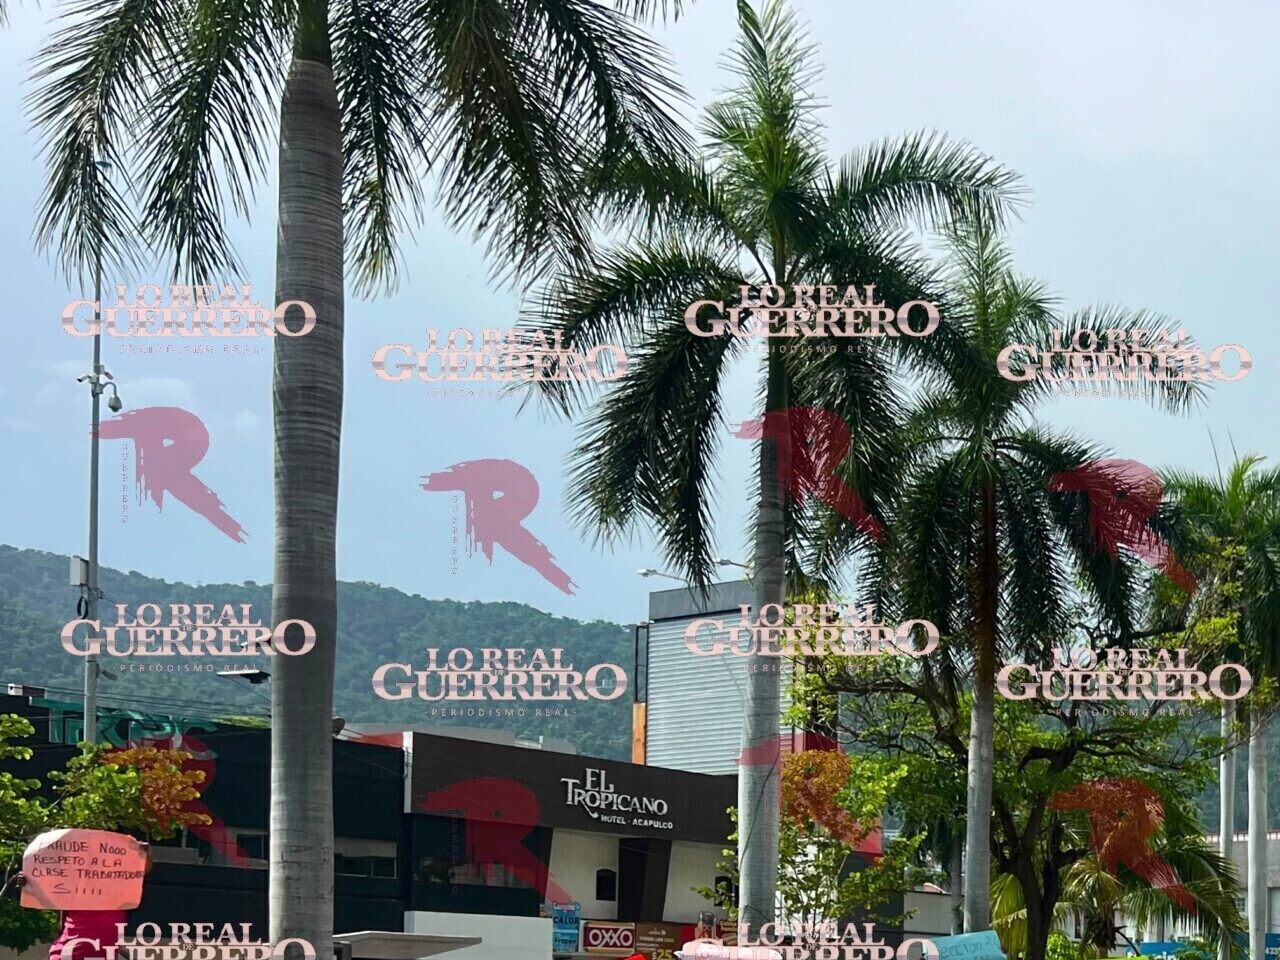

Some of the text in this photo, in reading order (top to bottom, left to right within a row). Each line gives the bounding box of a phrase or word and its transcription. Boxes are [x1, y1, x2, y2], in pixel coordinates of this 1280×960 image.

[585, 767, 614, 793] EL
[560, 778, 668, 819] TROPICANO
[601, 814, 673, 830] HOTEL ACAPULCO
[33, 855, 85, 866] RESPETO
[32, 867, 68, 878] CLASE
[589, 927, 633, 947] OXXO
